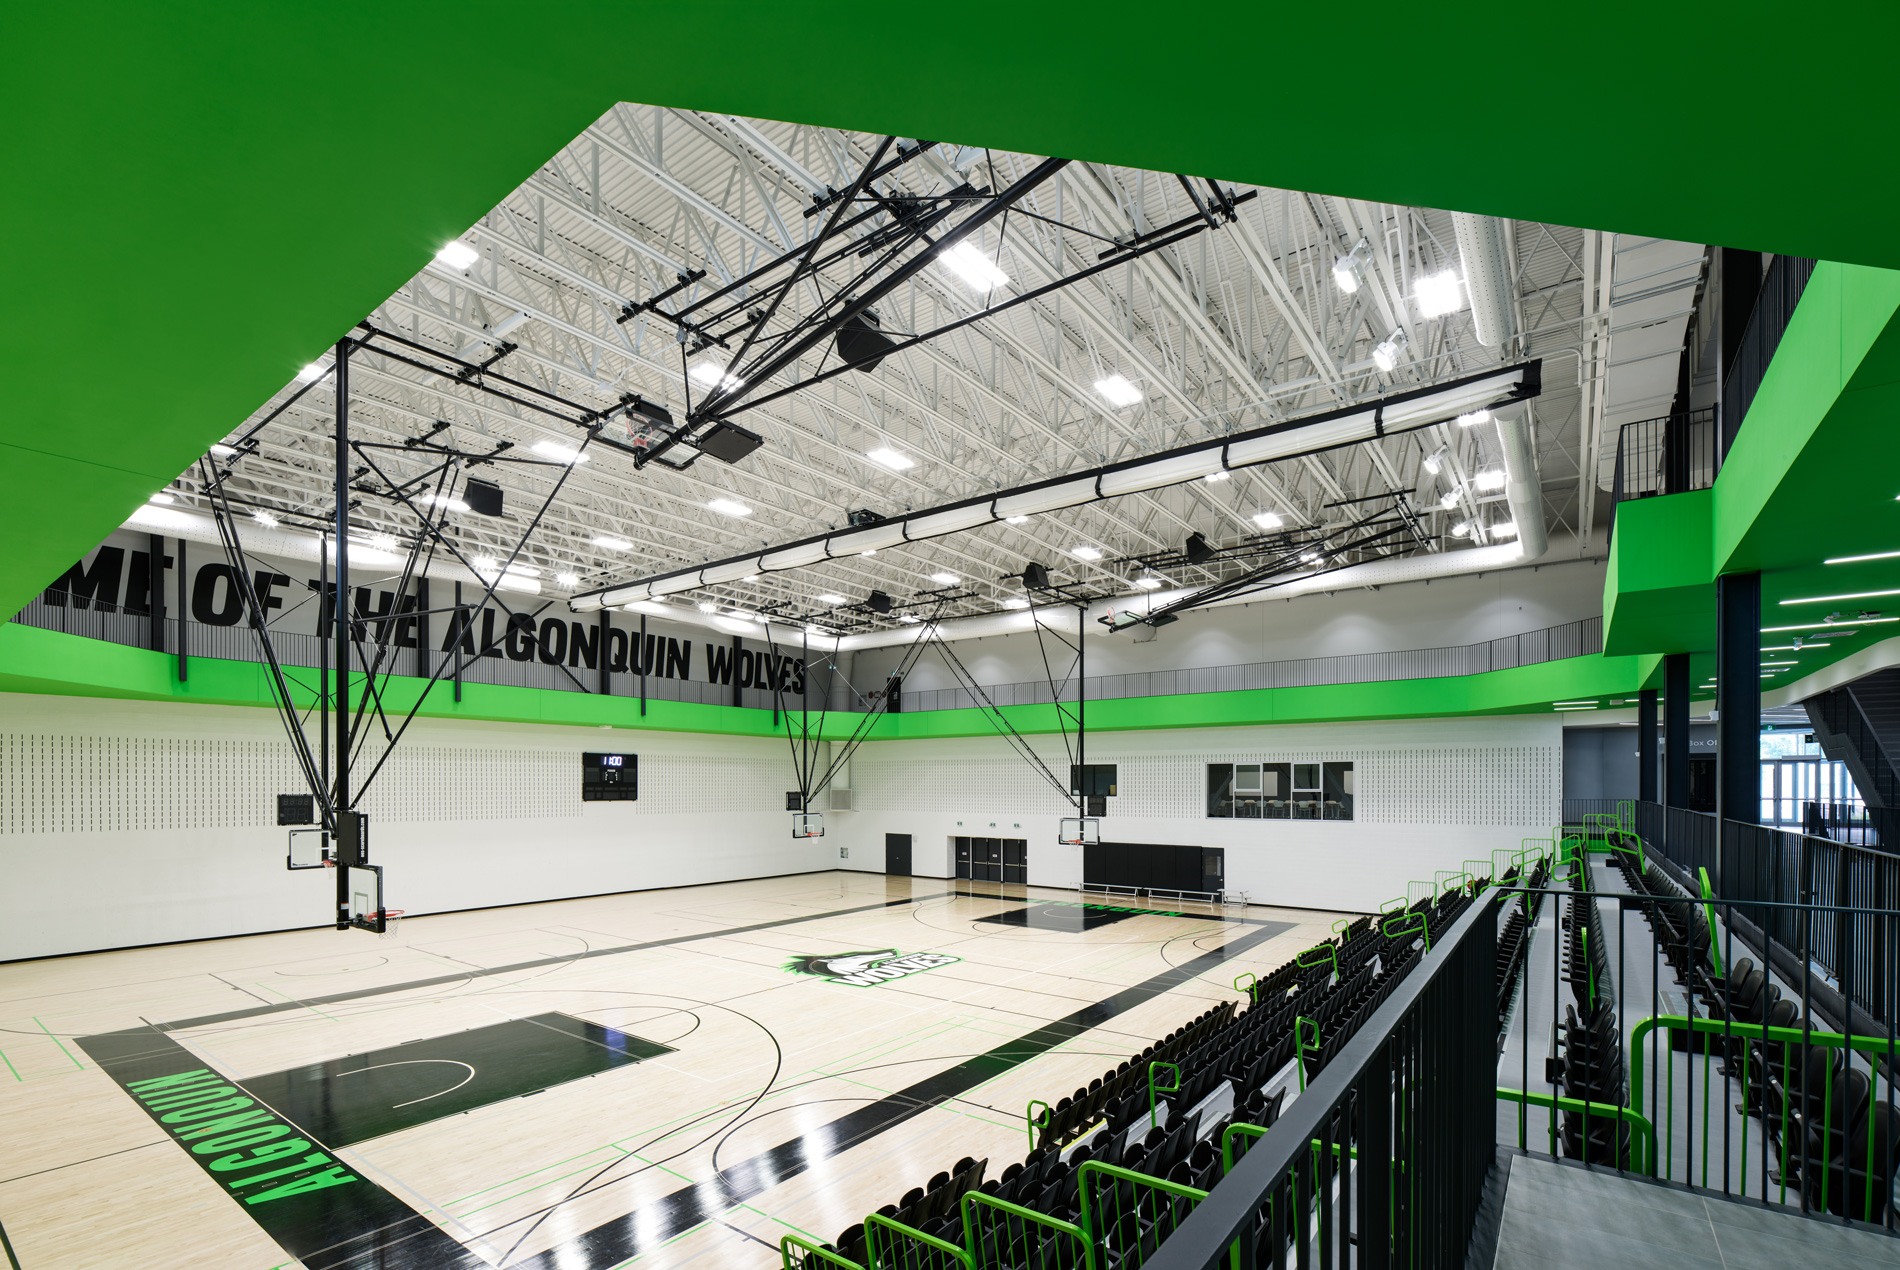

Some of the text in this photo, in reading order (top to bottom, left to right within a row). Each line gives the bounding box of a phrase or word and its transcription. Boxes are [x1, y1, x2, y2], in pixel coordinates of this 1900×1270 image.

[192, 563, 291, 630] OF
[308, 579, 417, 648] THE
[441, 603, 692, 681] ALGONQUIN
[706, 643, 807, 695] WOLVES
[829, 953, 960, 987] WOLVES
[126, 1069, 358, 1204] ALGONQUIN
